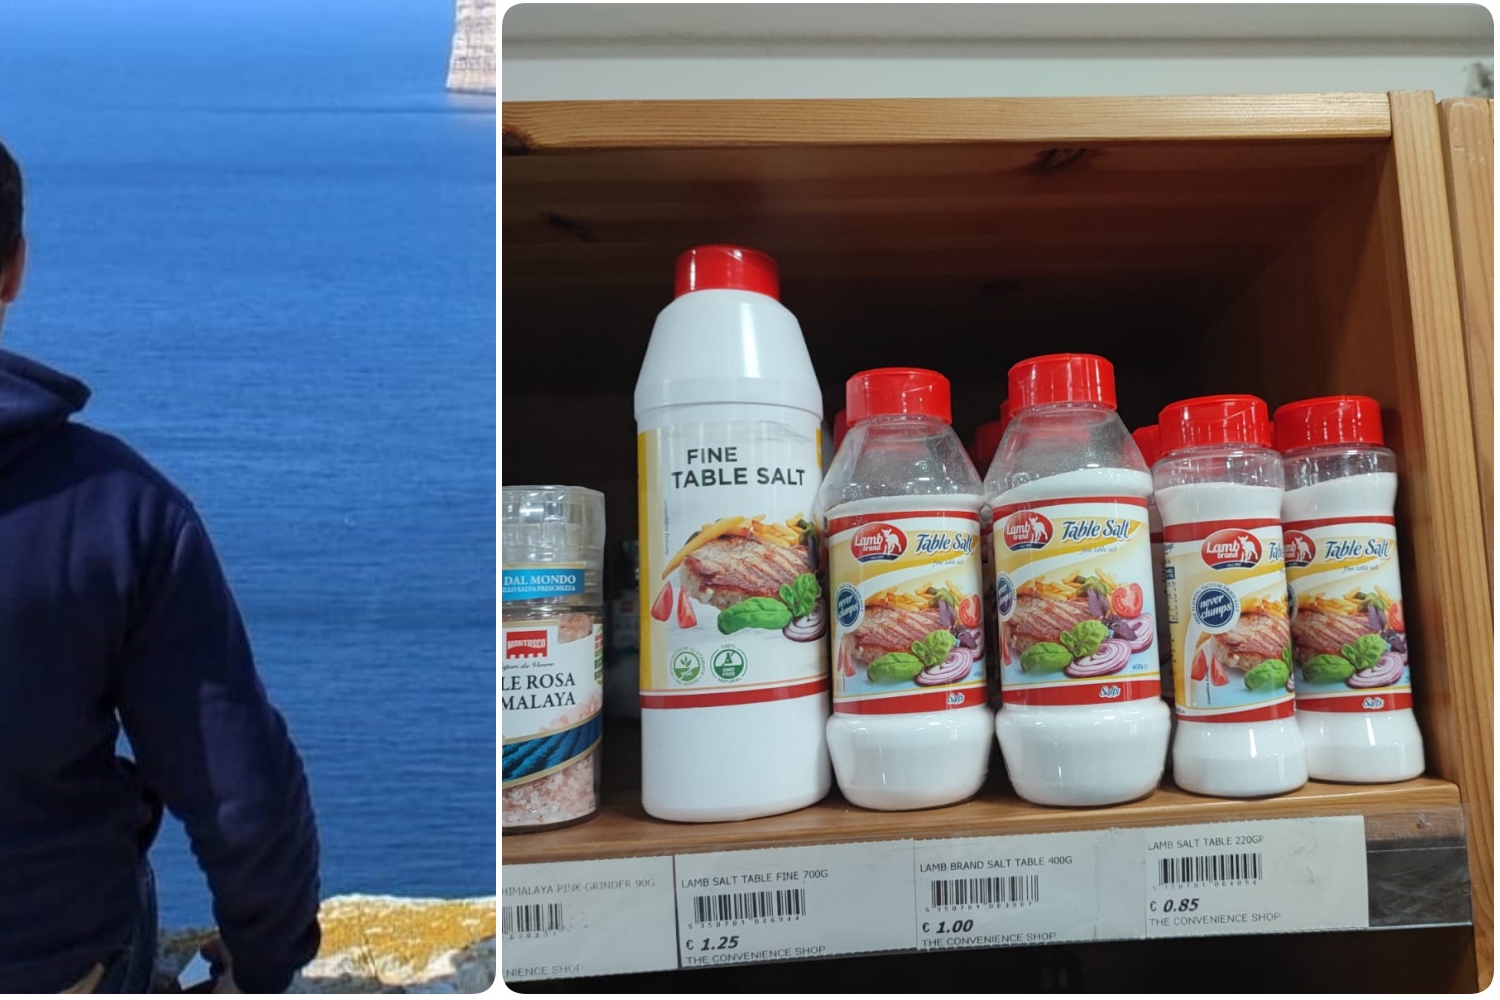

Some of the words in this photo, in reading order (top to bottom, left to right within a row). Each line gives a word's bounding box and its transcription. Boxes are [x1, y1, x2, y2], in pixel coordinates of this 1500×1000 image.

[687, 446, 738, 465] FINE
[671, 467, 748, 489] TABLE
[756, 467, 805, 486] SALT
[1006, 521, 1030, 535] Lamb
[1061, 520, 1100, 541] Table
[1102, 519, 1132, 538] Salt
[854, 533, 883, 547] Lamb
[915, 533, 951, 554] Table
[952, 533, 973, 552] Salt
[1206, 540, 1240, 554] Lamb
[1324, 540, 1361, 559] Table
[1364, 538, 1389, 557] Salt
[504, 576, 527, 586] DAL
[529, 574, 577, 586] MONDO
[1199, 595, 1225, 610] never
[1200, 603, 1232, 621] clumps
[528, 672, 576, 689] ROSA
[1176, 838, 1200, 849] SALT
[1203, 836, 1232, 847] TABLE
[920, 862, 947, 873] LAMB
[950, 860, 984, 871] BRAND
[987, 858, 1012, 869] SALT
[1014, 857, 1045, 868] TABLE
[1048, 855, 1073, 866] 400G
[556, 883, 581, 894] PINK
[585, 880, 632, 892] GRINDER
[681, 878, 710, 889] LAMB
[712, 876, 738, 887] SALT
[740, 873, 772, 884] TABLE
[776, 871, 799, 882] FINE
[803, 869, 829, 880] 700G
[1162, 897, 1200, 914] 0.85
[935, 919, 974, 934] 1.00
[700, 935, 740, 951] 1.25
[686, 956, 709, 965] THE
[712, 948, 792, 964] CONVENIENCE
[795, 945, 826, 956] SHOP
